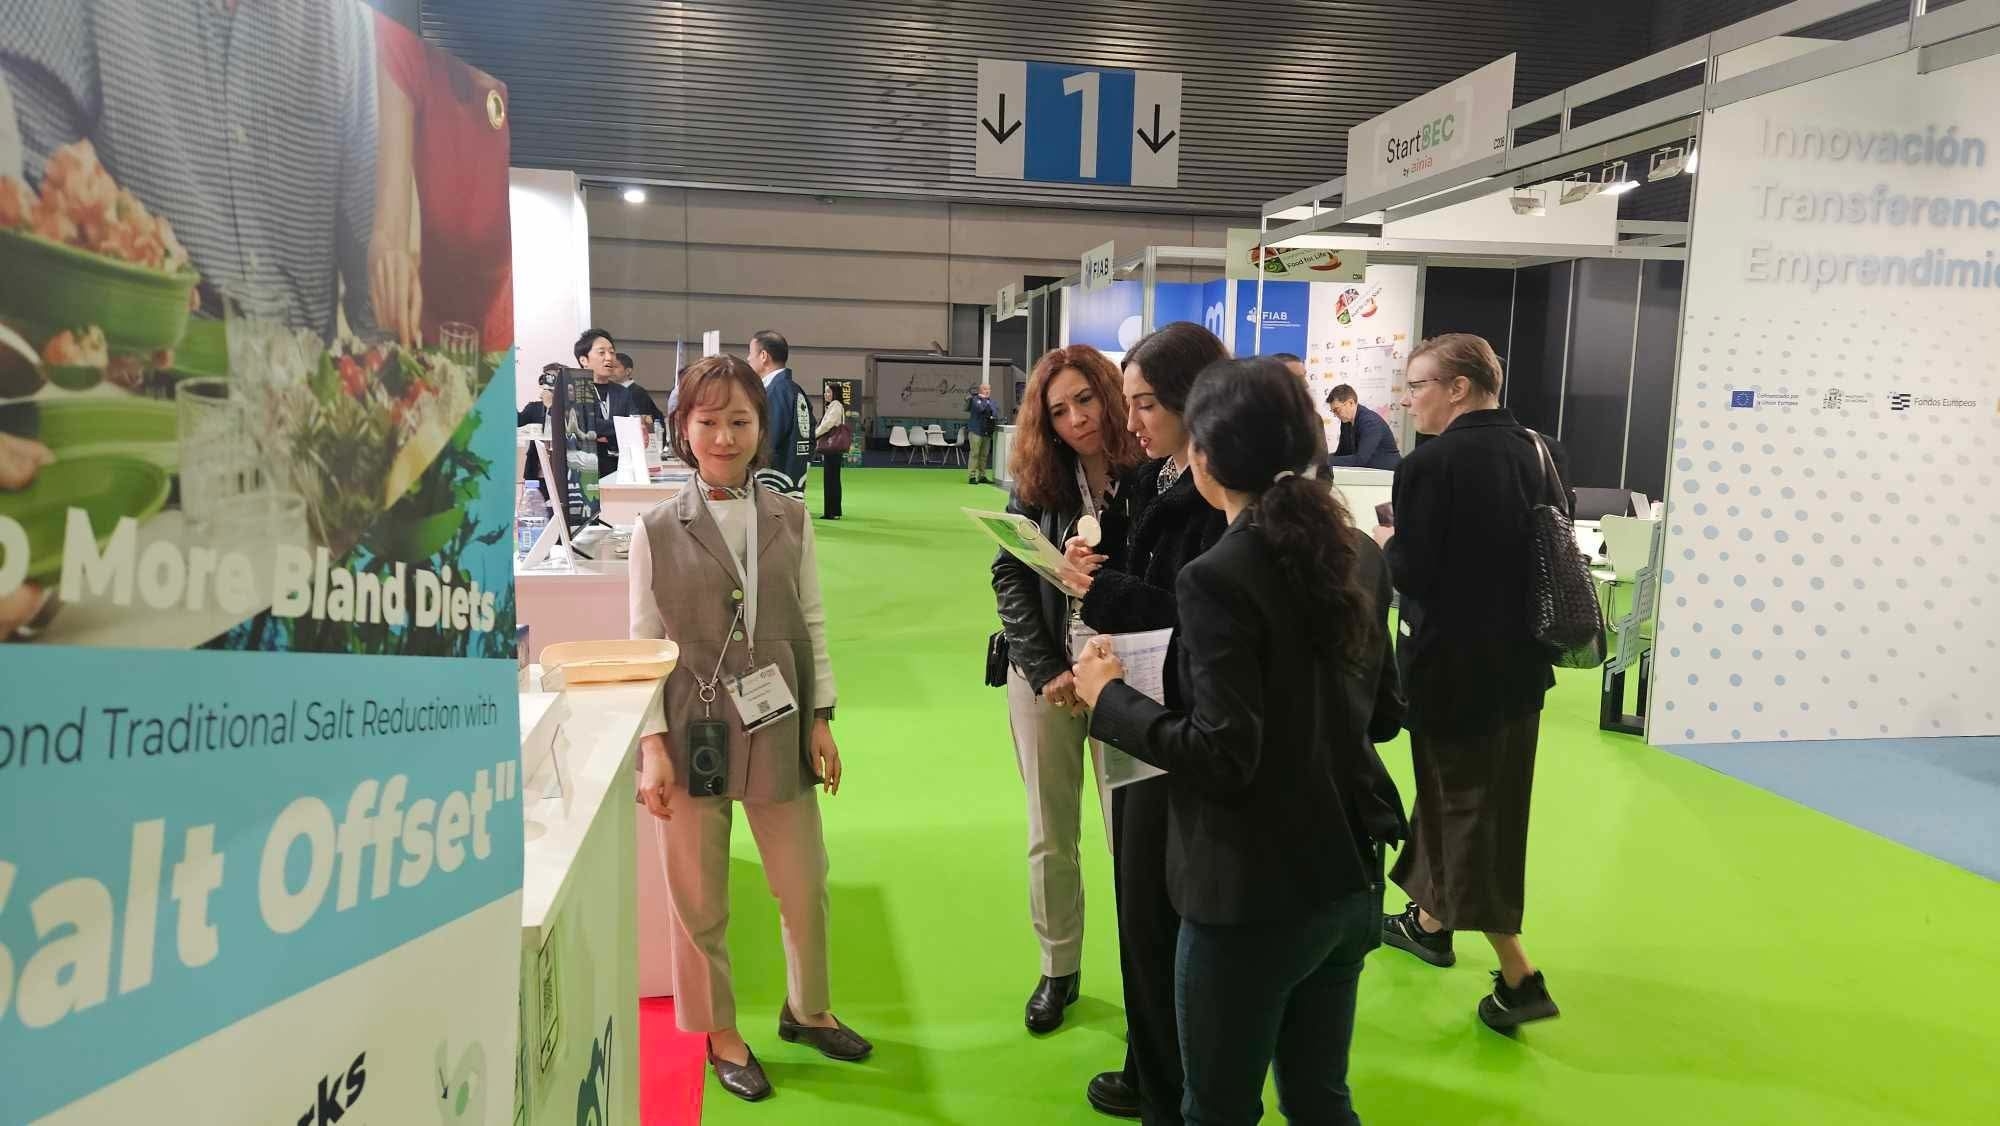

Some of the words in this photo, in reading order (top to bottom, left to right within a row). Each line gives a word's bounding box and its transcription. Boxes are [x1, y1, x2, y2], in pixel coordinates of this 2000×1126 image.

[1062, 71, 1100, 179] 1
[1386, 113, 1455, 164] StartBEC
[1759, 118, 1986, 168] Innovación
[1403, 167, 1410, 177] by
[1093, 257, 1109, 276] FIAB
[1286, 257, 1304, 268] Food
[1262, 311, 1288, 321] FIAB
[842, 382, 852, 405] AREA
[1914, 398, 1941, 408] Fondos
[1942, 398, 1977, 409] Europeos
[58, 506, 256, 612] More
[271, 545, 407, 626] Bland
[415, 566, 496, 633] Diets
[102, 699, 298, 761] Traditional
[304, 699, 355, 743] Salt
[362, 696, 462, 738] Reduction
[463, 694, 498, 729] with
[0, 818, 225, 1030] alt
